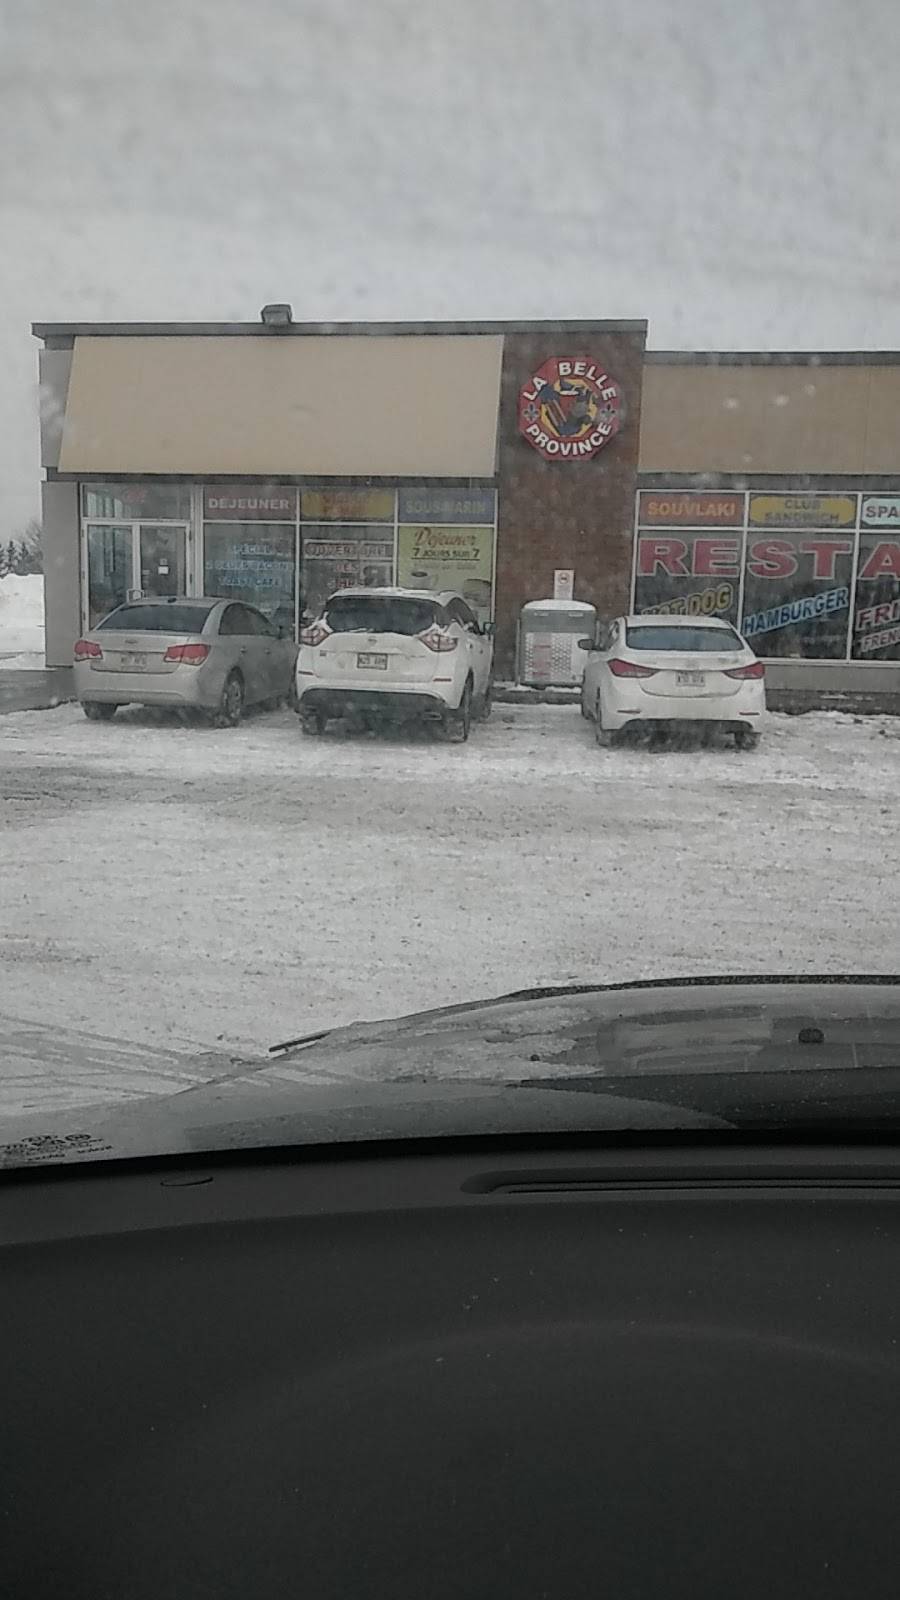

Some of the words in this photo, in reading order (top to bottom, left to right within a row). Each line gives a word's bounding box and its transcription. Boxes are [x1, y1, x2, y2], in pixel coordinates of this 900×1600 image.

[522, 376, 547, 401] LA
[558, 361, 616, 401] BELLE
[526, 422, 612, 456] PROVINCE
[647, 501, 736, 517] SOUVLAKI
[785, 499, 820, 510] CLUB
[412, 547, 420, 557] 7
[472, 548, 480, 558] 7
[687, 582, 733, 617] DOG
[743, 587, 849, 637] HAMBURGER
[861, 628, 900, 652] FREN
